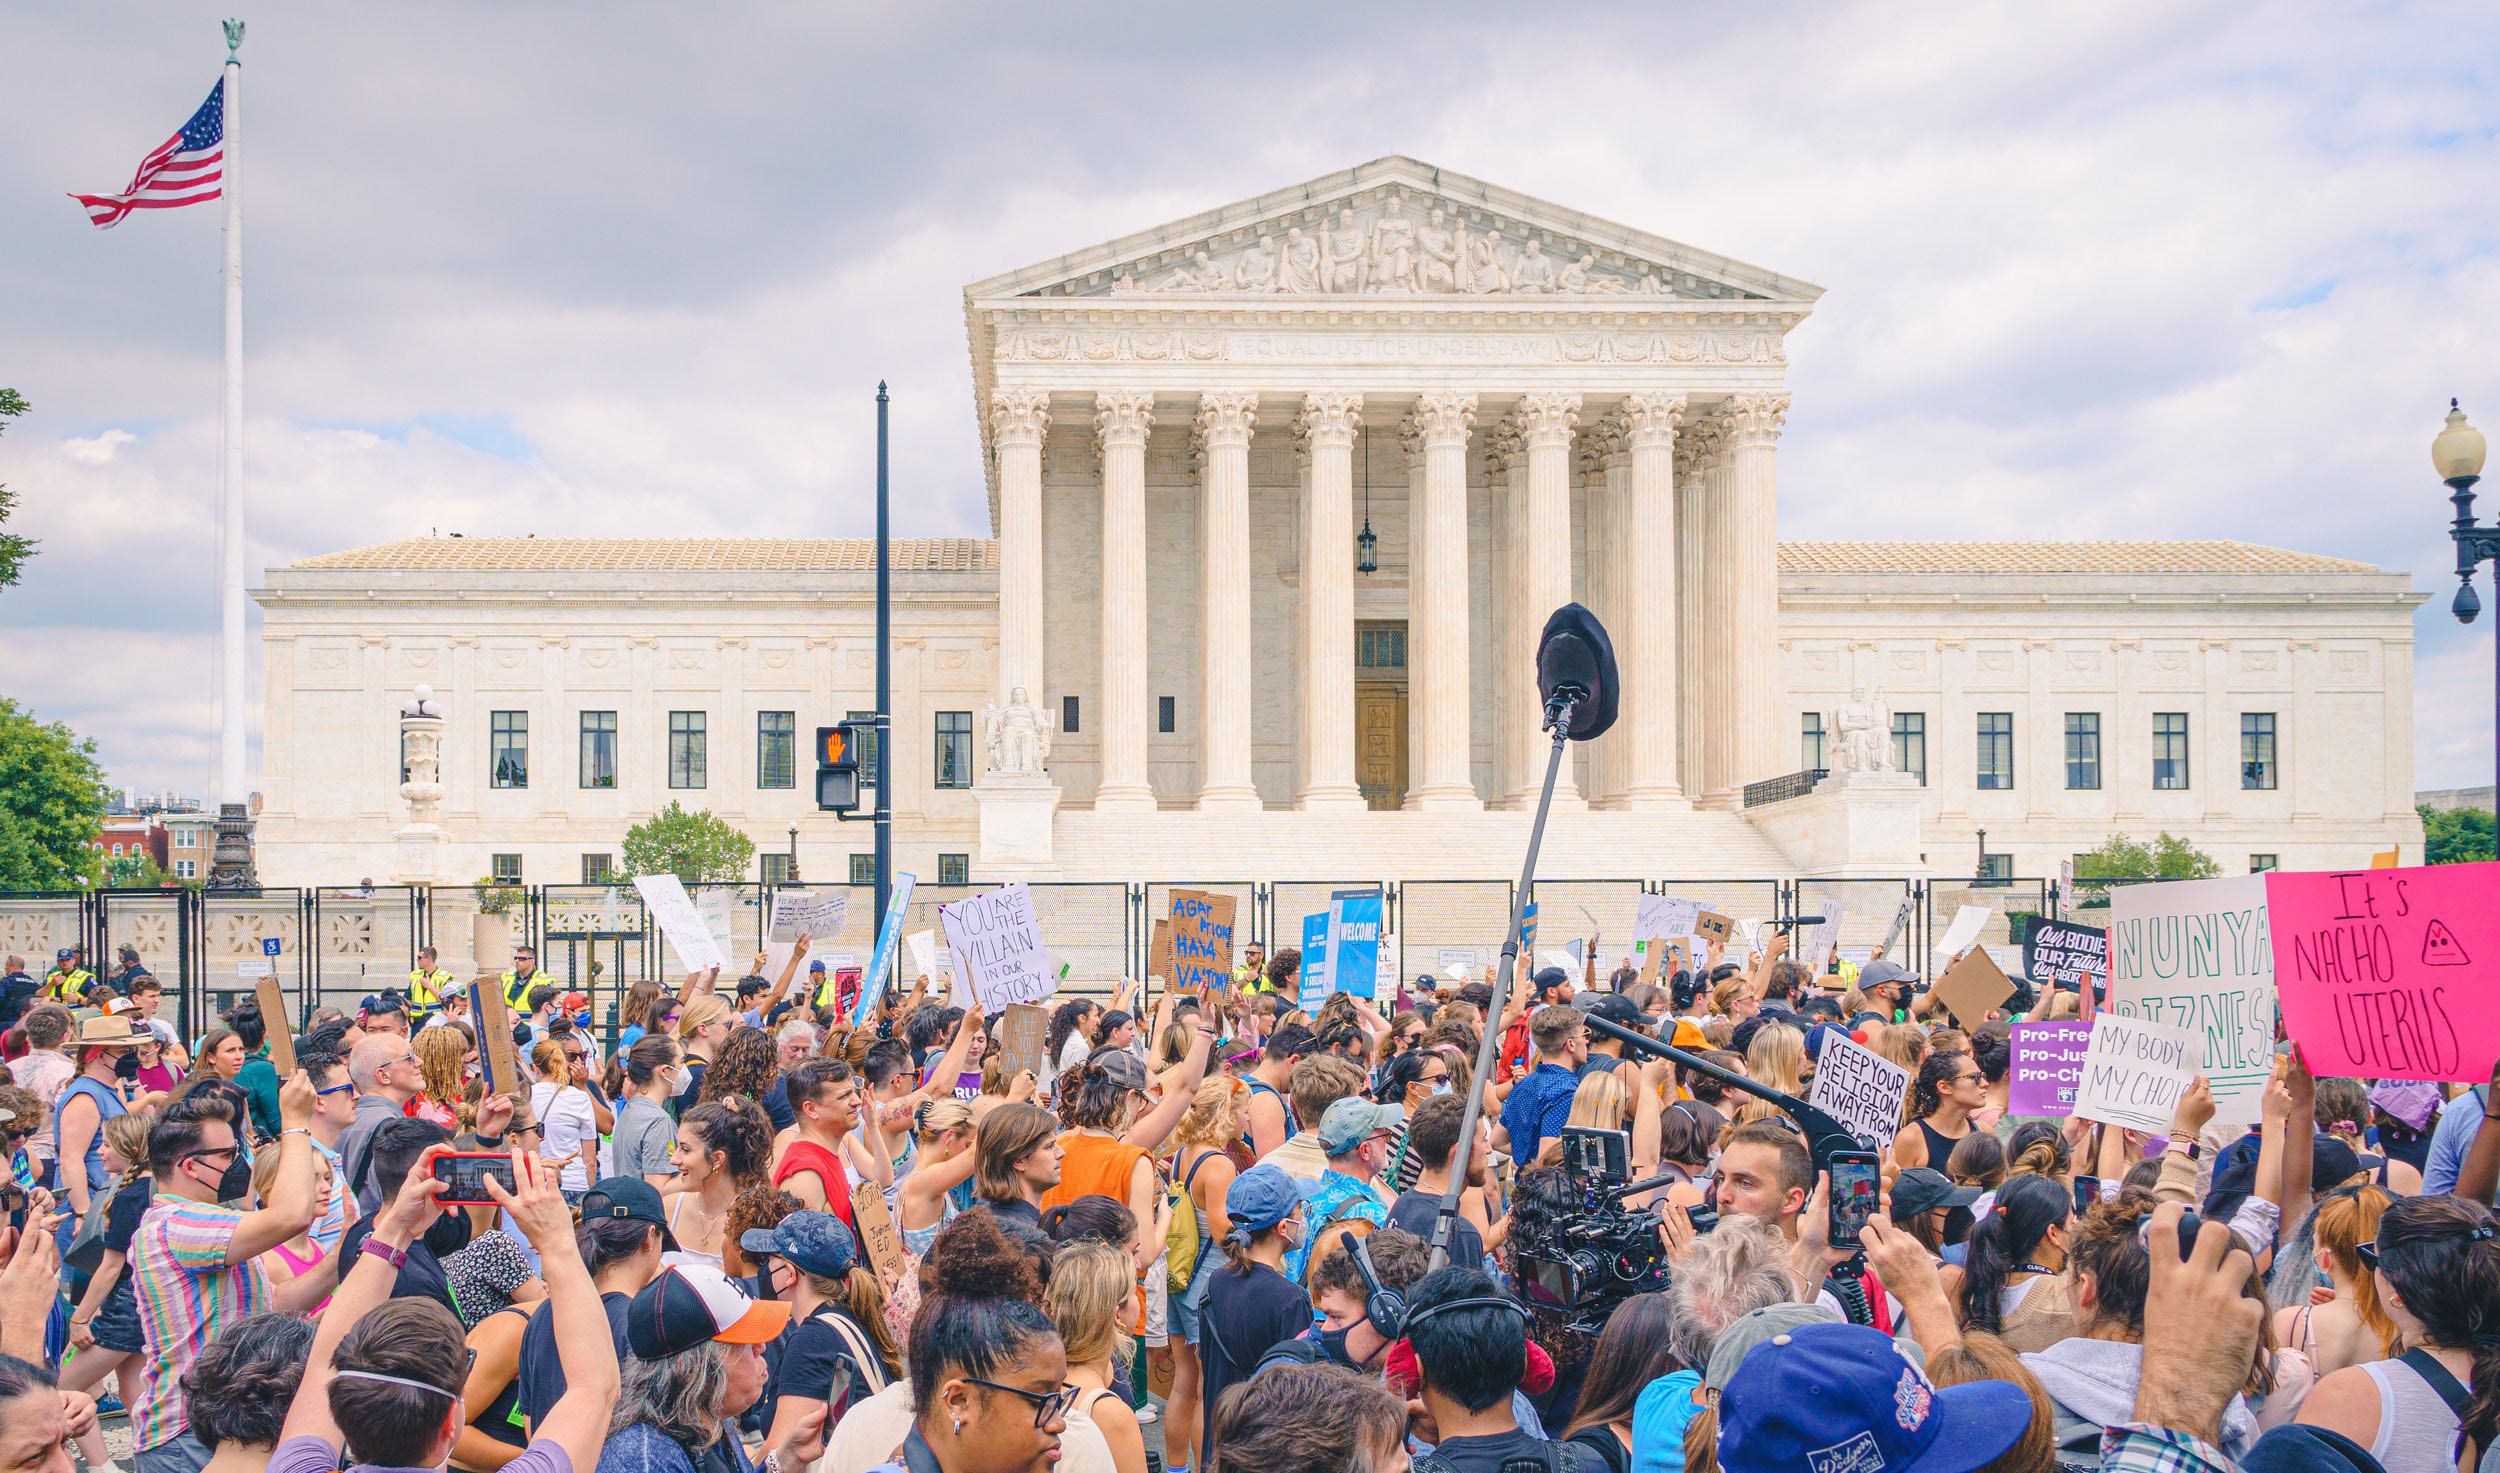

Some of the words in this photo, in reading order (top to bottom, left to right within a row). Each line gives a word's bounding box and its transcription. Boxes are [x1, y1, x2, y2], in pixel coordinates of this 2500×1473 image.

[1243, 339, 1314, 357] EQUAL
[1327, 339, 1407, 357] JUSTICE
[1418, 339, 1487, 357] UNDER
[1497, 339, 1540, 357] LAW
[945, 899, 995, 937] YOU
[995, 891, 1026, 914] ARE
[2329, 873, 2409, 920] It's
[995, 909, 1027, 930] THE
[1340, 921, 1378, 942] WELCOME
[957, 927, 1034, 967] VILLAIN
[2034, 946, 2066, 966] OUR
[2035, 925, 2067, 948] Our
[2065, 931, 2106, 955] BODIE
[2116, 904, 2273, 980] NUNYA
[2294, 924, 2394, 984] NACHO
[984, 967, 999, 982] IN
[1002, 960, 1025, 977] OUR
[2032, 960, 2056, 978] Our
[981, 971, 1044, 1012] HISTORY
[2019, 1028, 2091, 1043] Pro-Fre
[2098, 1025, 2132, 1056] MY
[2137, 1032, 2185, 1070] BODY
[2334, 986, 2460, 1076] UTERUS
[1004, 1052, 1019, 1073] IN
[1829, 1037, 1870, 1077] KEEP
[1871, 1058, 1905, 1099] YOUR
[2018, 1067, 2082, 1082] Pro-Ch
[2019, 1048, 2088, 1062] Pro-Jus
[1819, 1055, 1900, 1120] RELIGION
[2088, 1063, 2129, 1102] MY
[1817, 1080, 1863, 1123] AWAY
[1861, 1105, 1895, 1141] FROM
